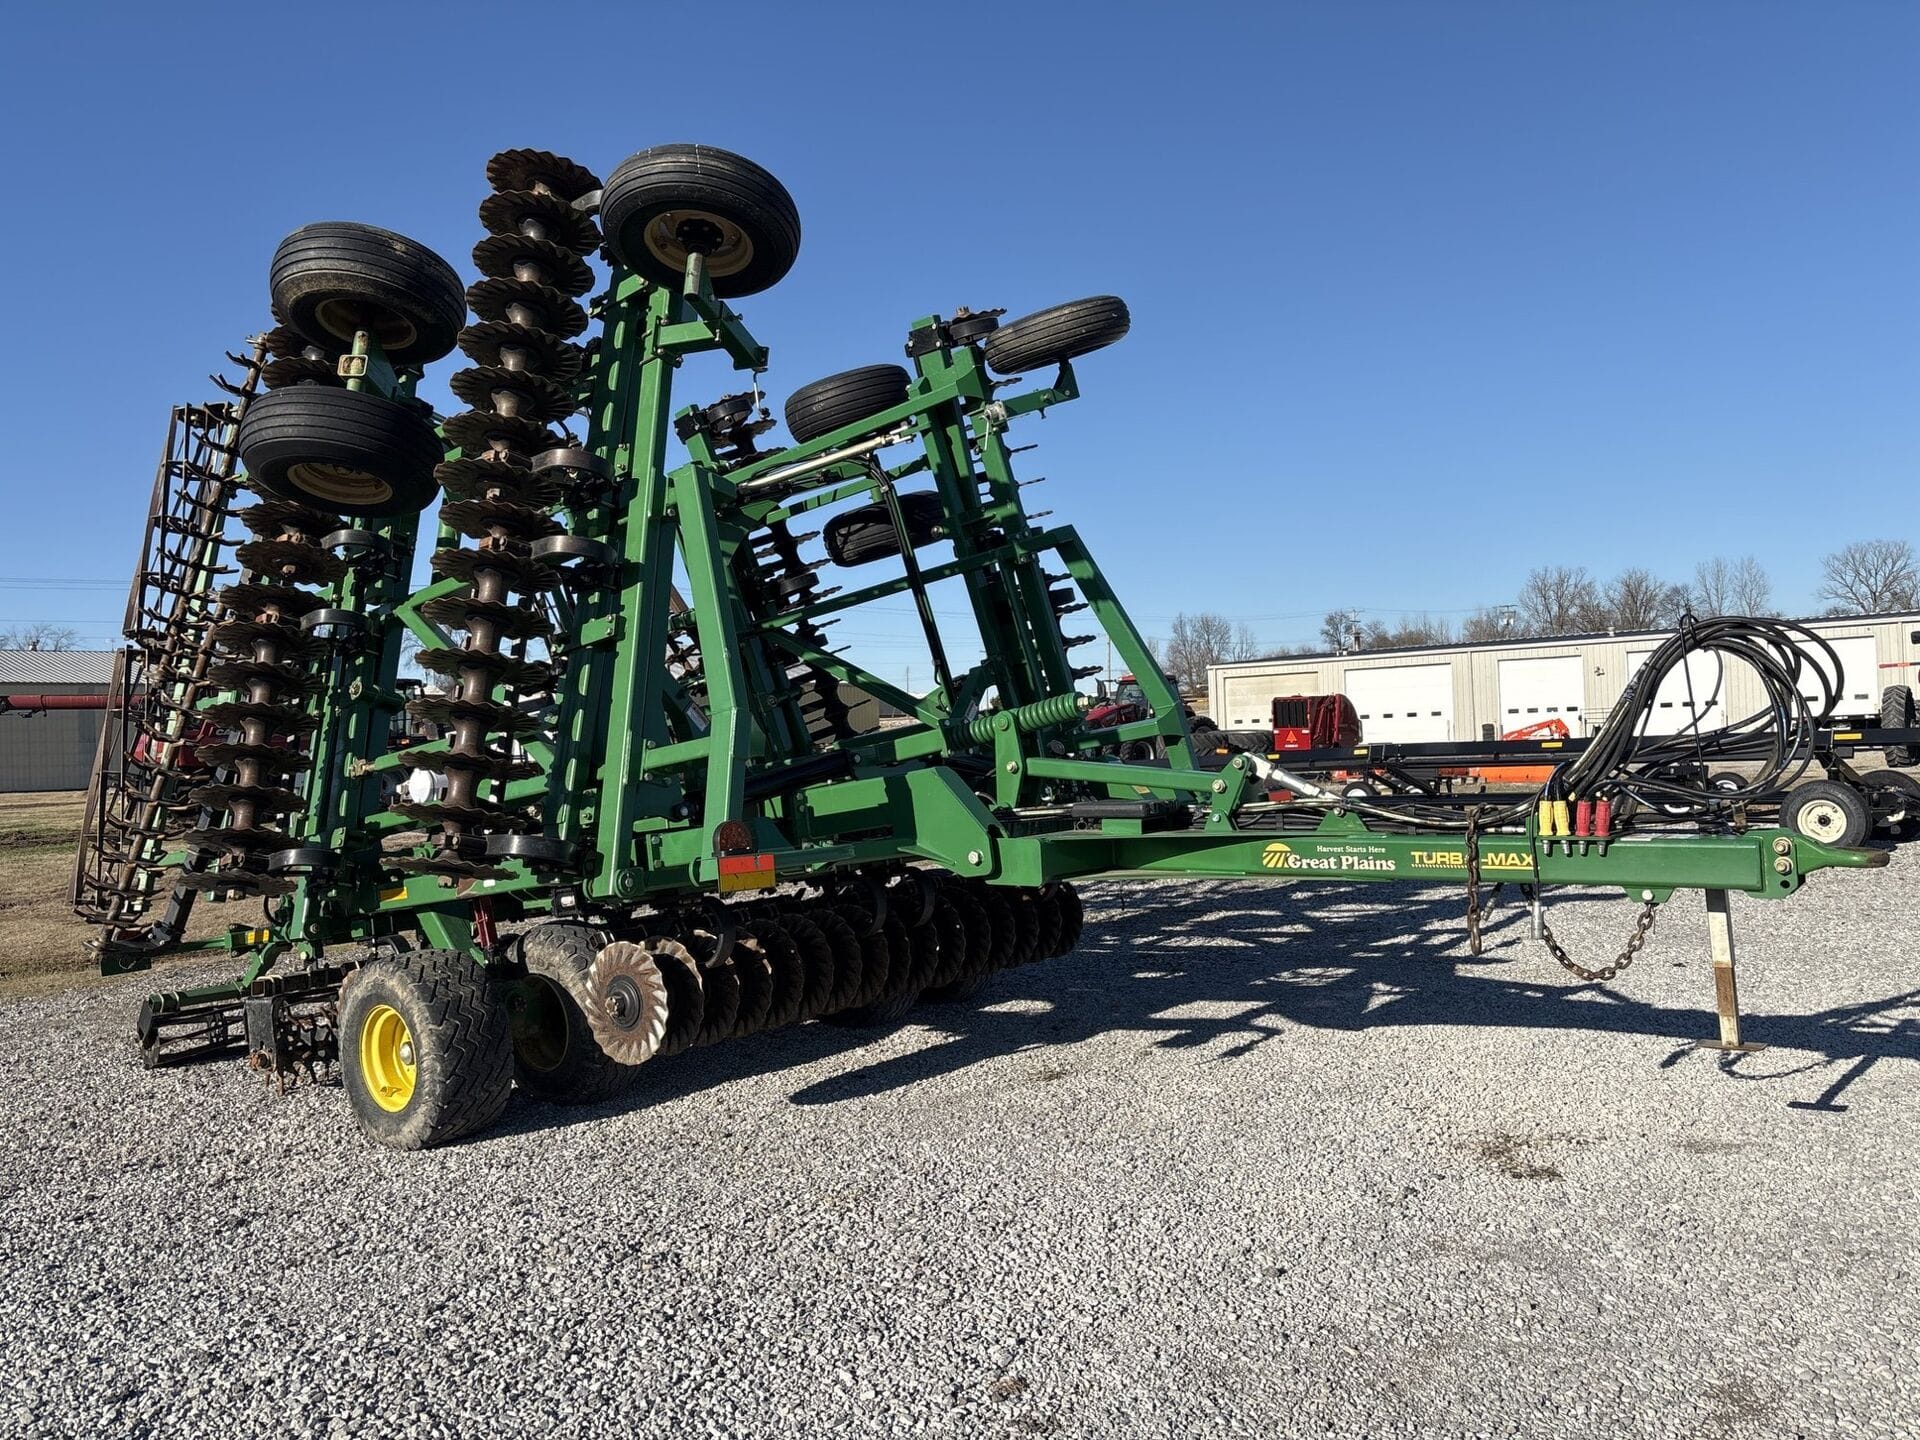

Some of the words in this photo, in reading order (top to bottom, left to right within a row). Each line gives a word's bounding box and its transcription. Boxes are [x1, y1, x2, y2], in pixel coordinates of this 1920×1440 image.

[1317, 845, 1344, 853] Harvest
[1345, 845, 1366, 853] Starts
[1368, 845, 1386, 853] Here
[1287, 854, 1338, 869] Great
[1340, 855, 1396, 871] Plains
[1411, 851, 1534, 866] TURB-MAX
